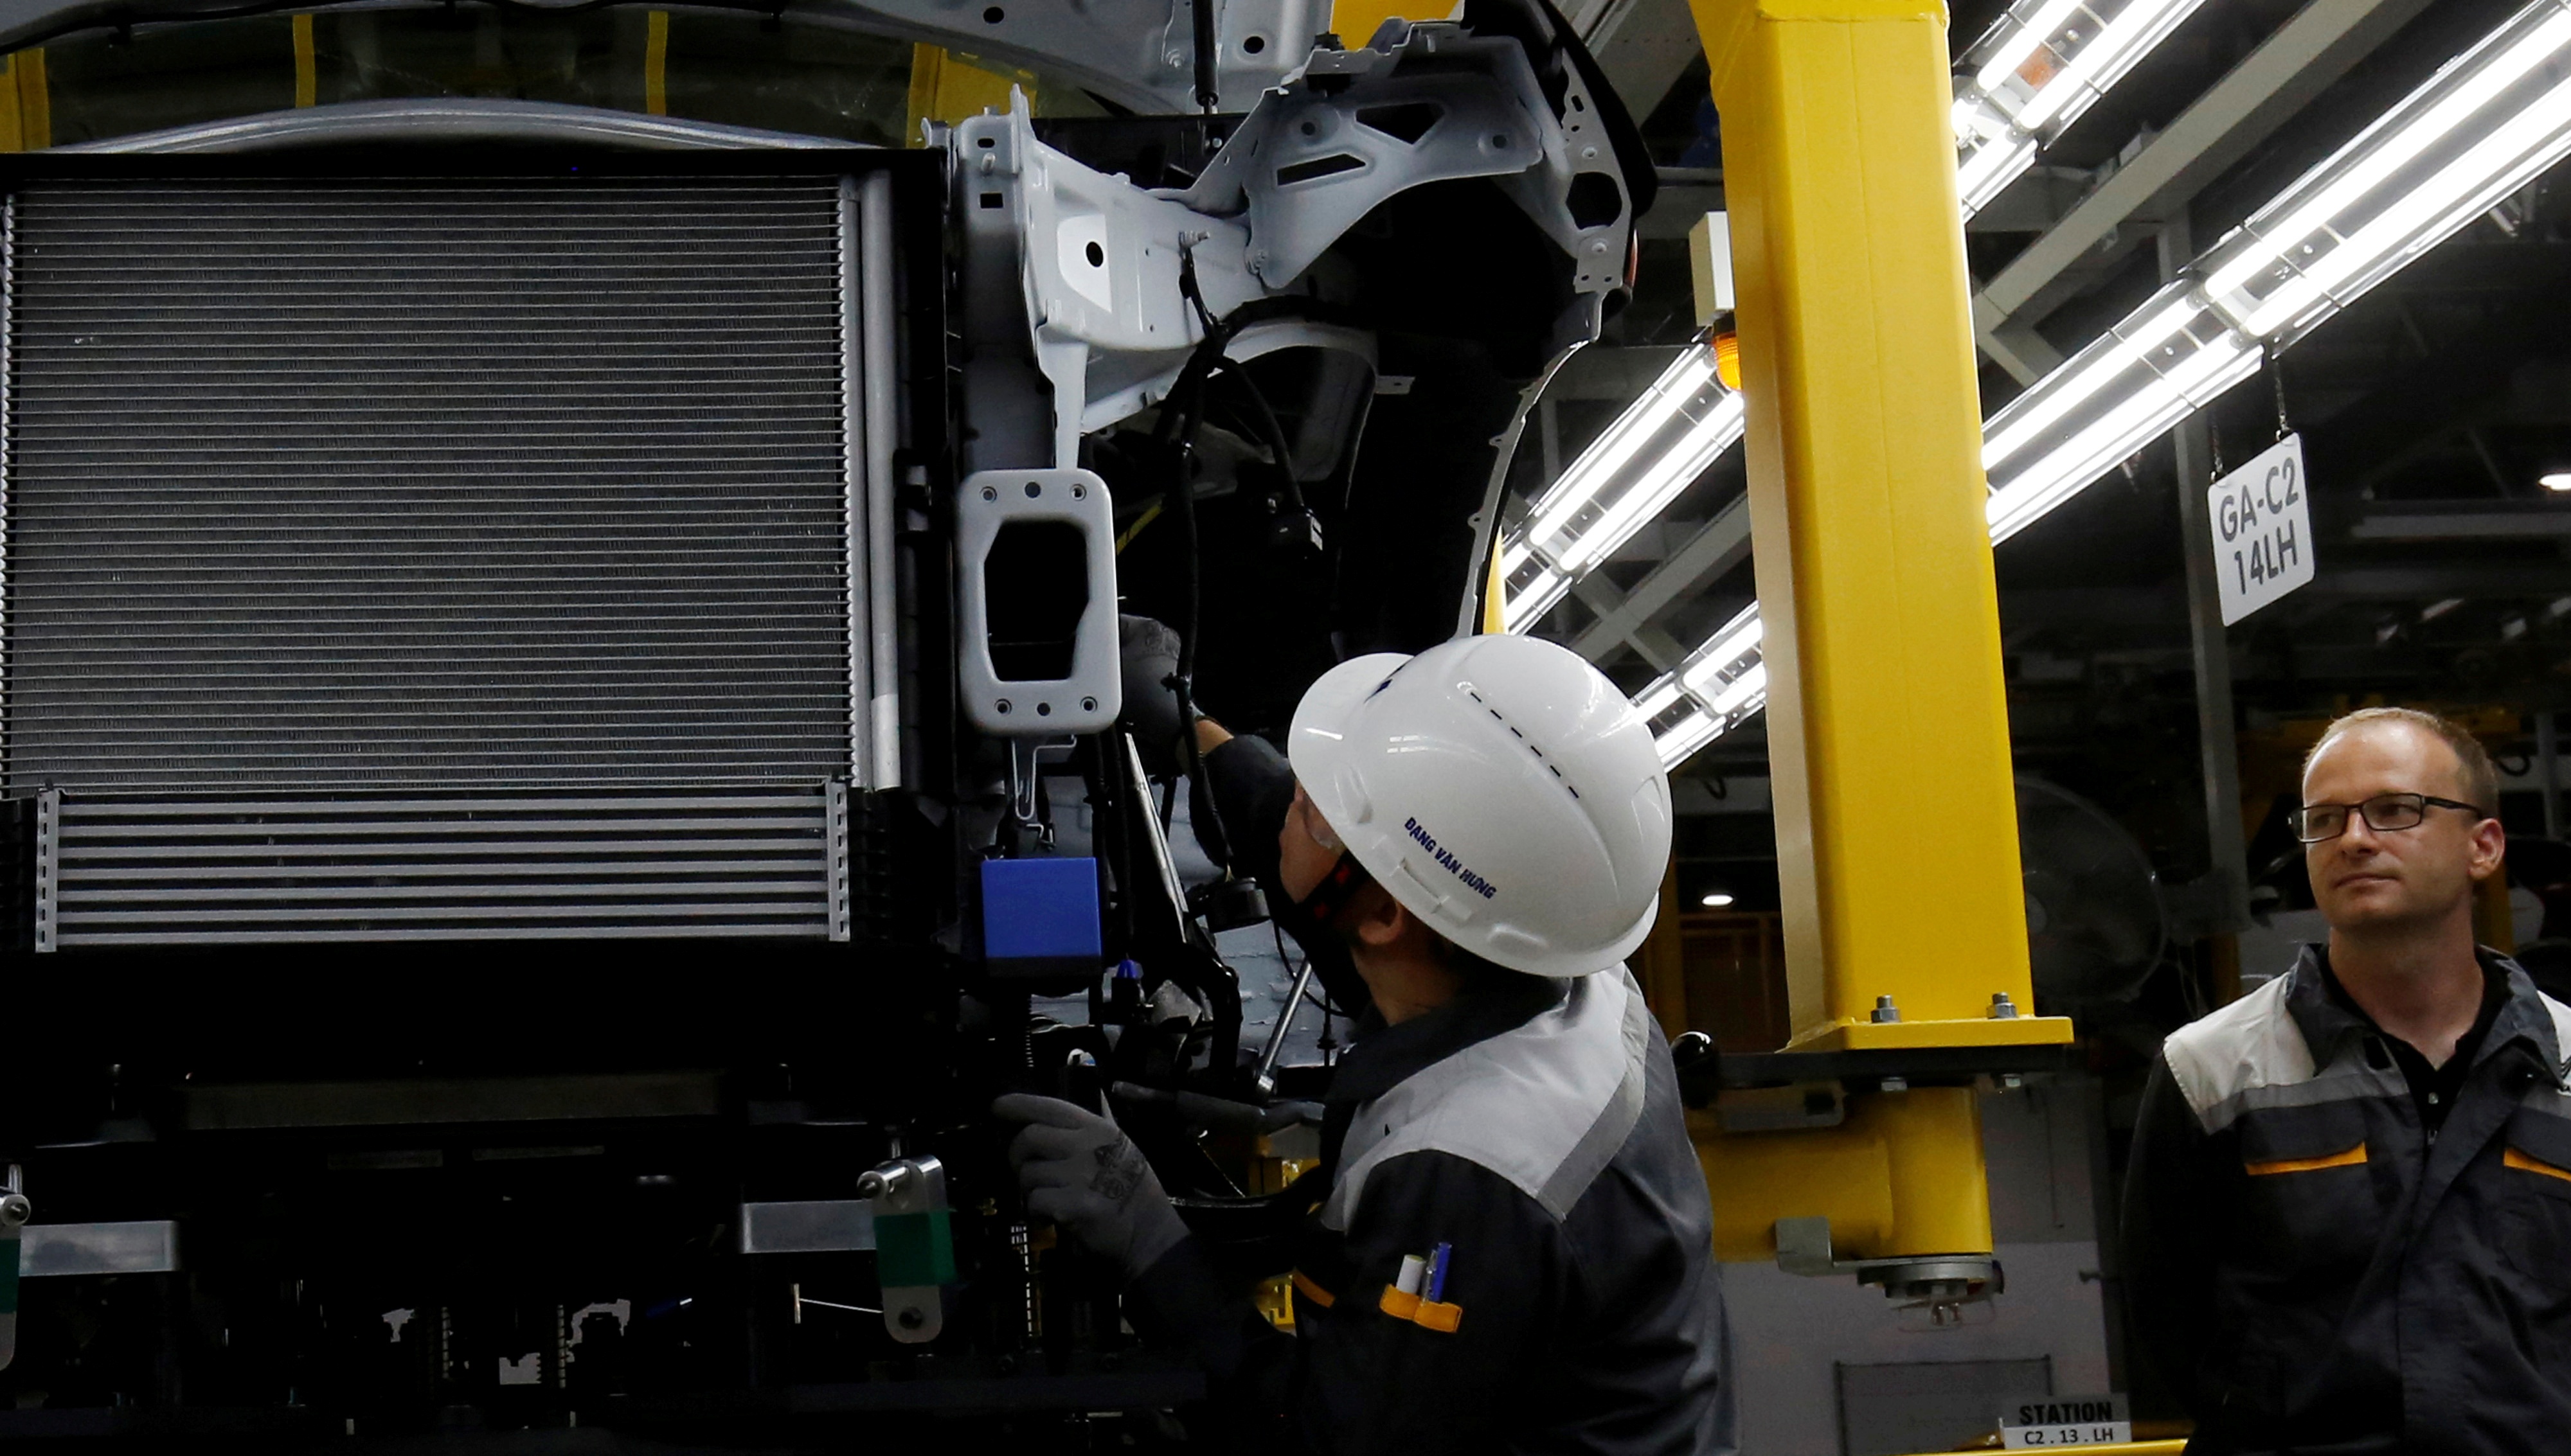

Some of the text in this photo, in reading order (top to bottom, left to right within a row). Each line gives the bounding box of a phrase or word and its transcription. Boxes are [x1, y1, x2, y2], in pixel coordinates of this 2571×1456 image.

[2219, 457, 2298, 542] GA-C2
[2234, 519, 2297, 595] 14LH
[2019, 1401, 2112, 1425] STATION
